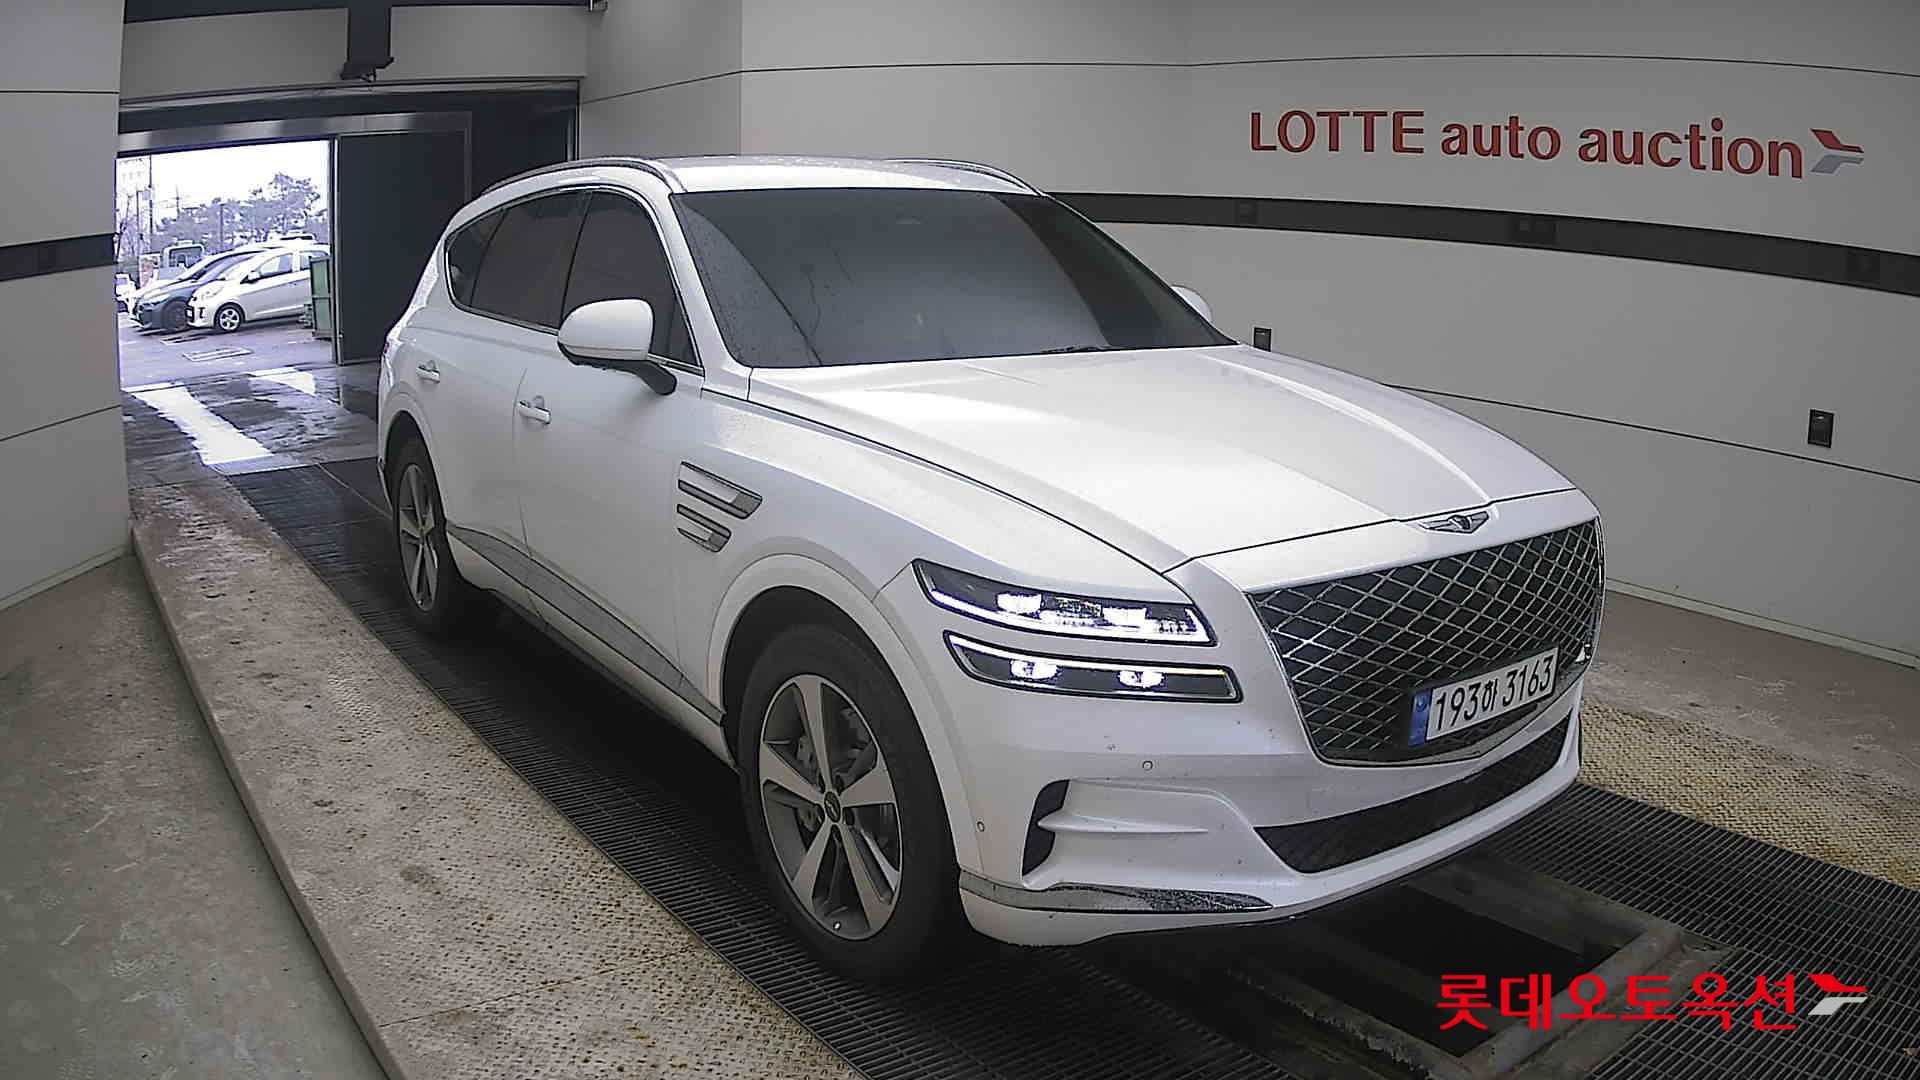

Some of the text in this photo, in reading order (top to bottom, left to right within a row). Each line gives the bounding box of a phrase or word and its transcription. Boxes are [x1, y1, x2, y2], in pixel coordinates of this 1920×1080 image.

[1251, 110, 1803, 178] LOTTE auto auction
[1436, 655, 1554, 731] 193하 3163
